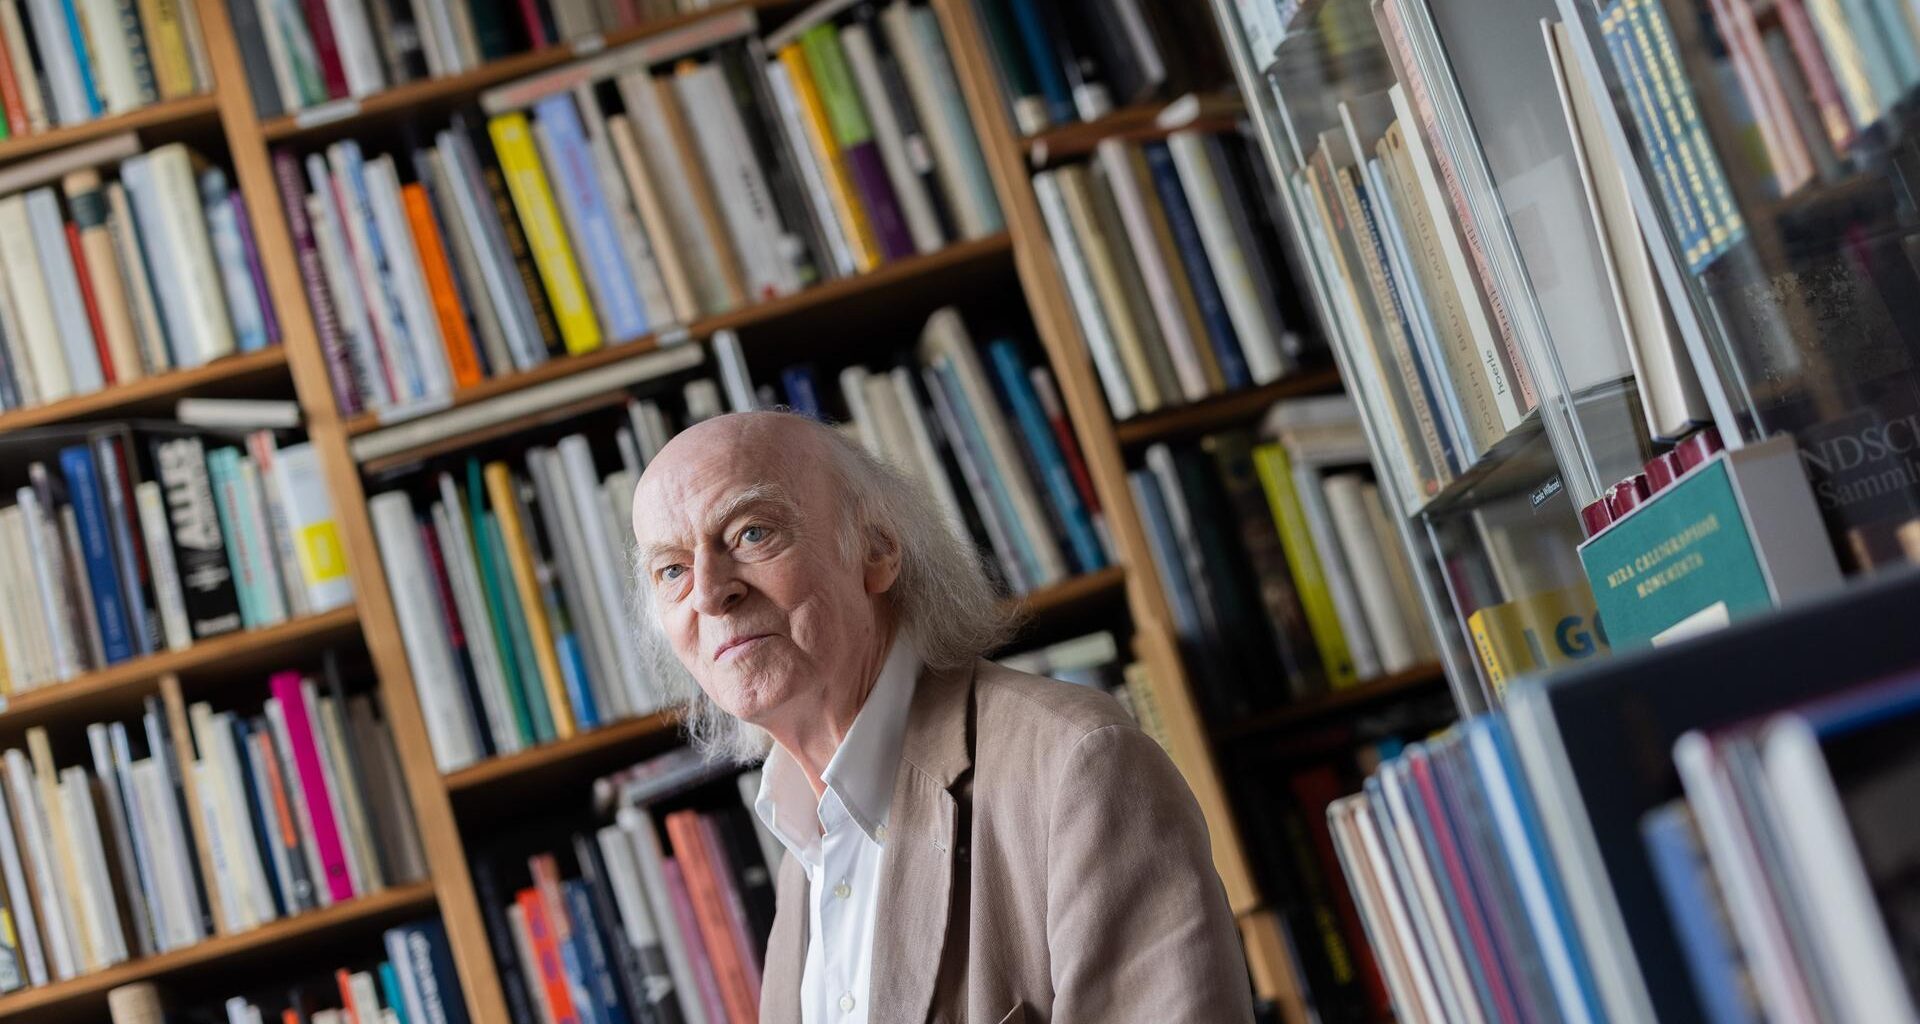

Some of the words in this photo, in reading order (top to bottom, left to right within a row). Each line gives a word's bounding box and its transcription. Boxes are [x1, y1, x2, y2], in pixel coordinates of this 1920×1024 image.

[1444, 291, 1468, 352] BEUYS
[1466, 362, 1496, 435] JOSEPH
[1486, 348, 1506, 396] hoerle
